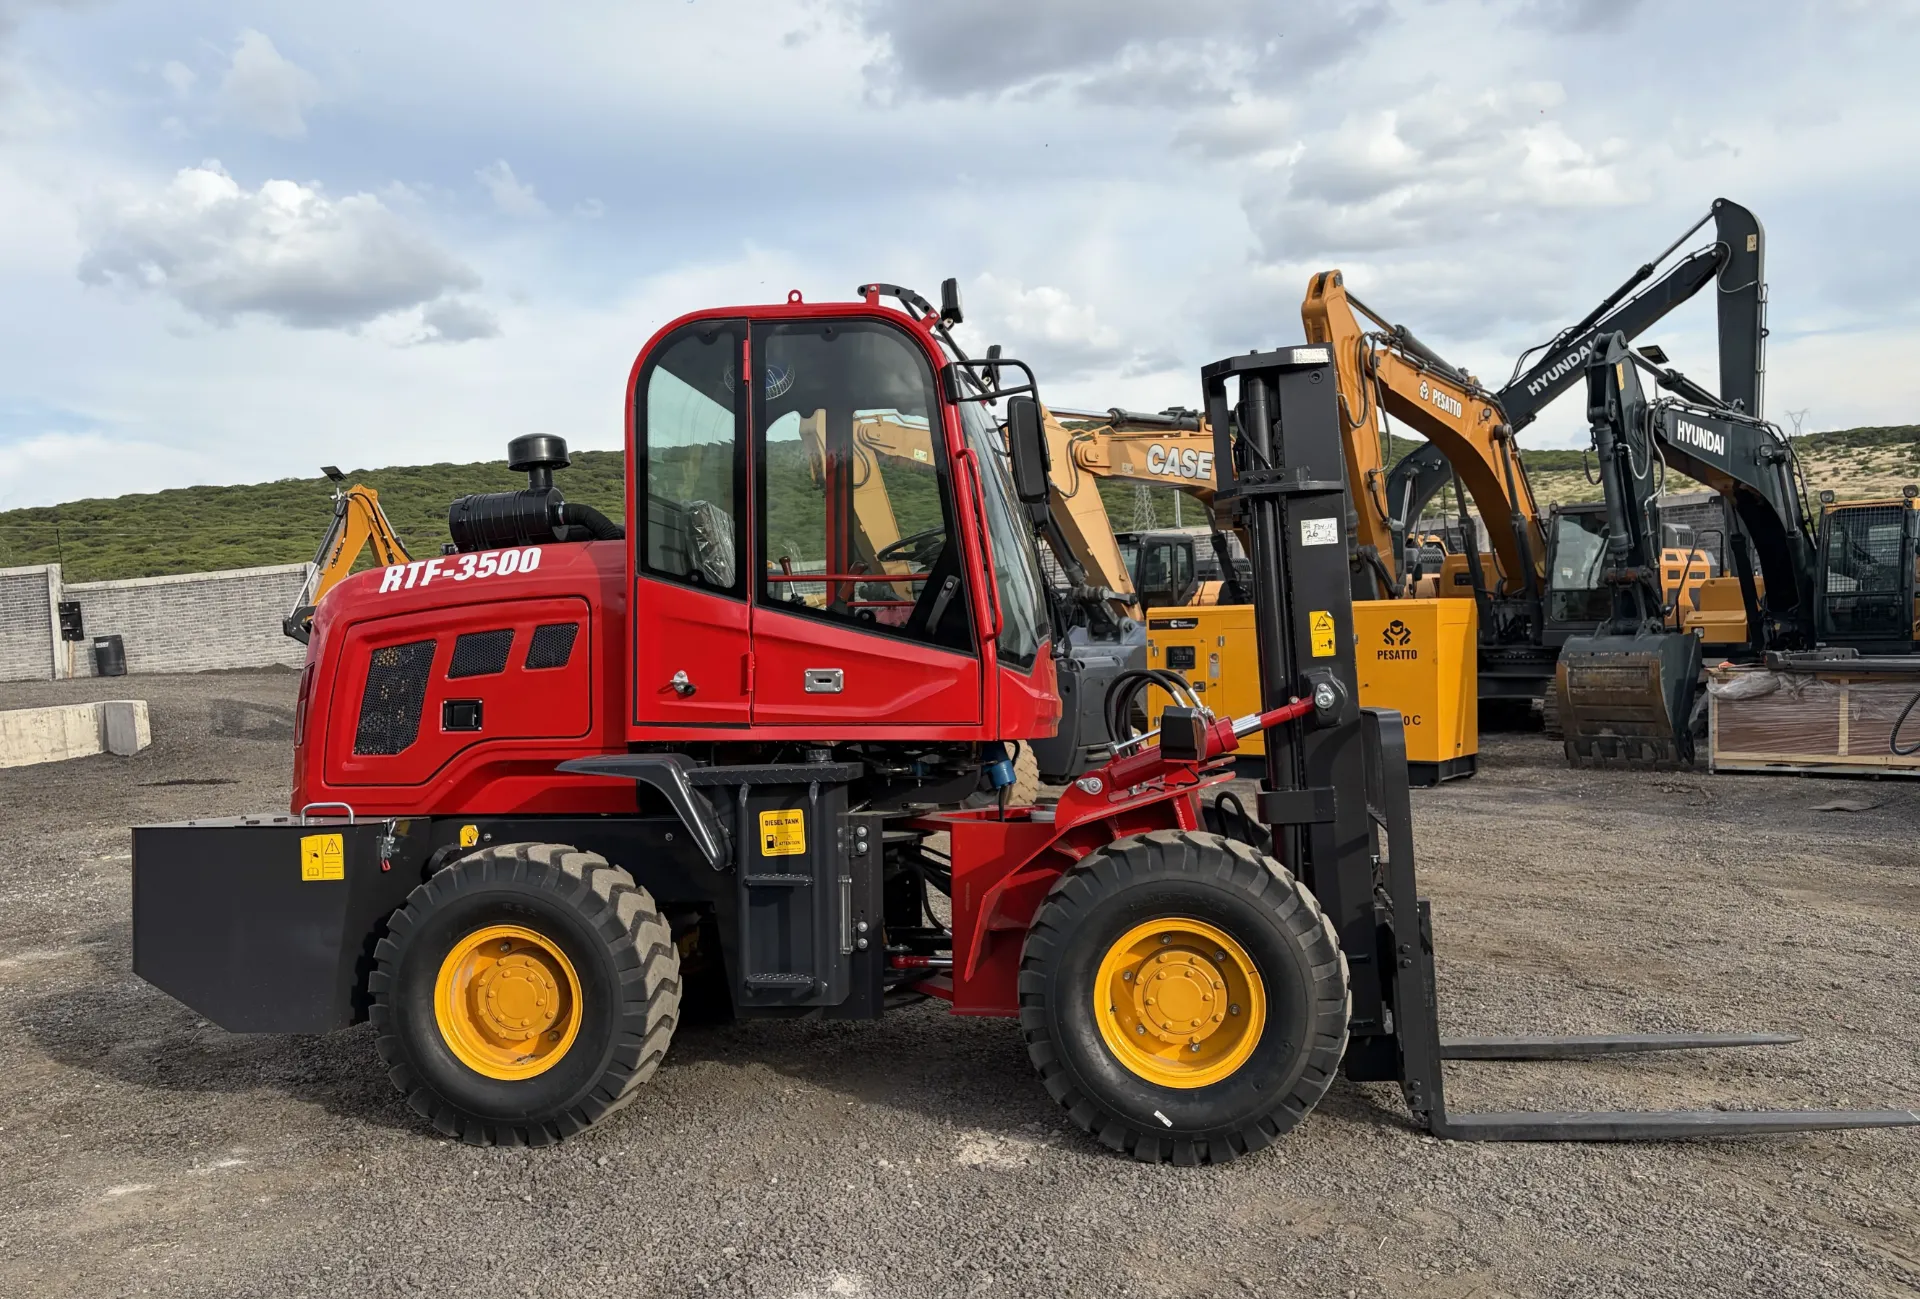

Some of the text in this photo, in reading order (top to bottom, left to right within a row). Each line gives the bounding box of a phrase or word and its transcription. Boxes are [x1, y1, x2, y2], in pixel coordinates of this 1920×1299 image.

[1432, 387, 1462, 419] PESATTO
[1677, 419, 1725, 456] HYUNDAI
[1146, 443, 1214, 480] CASE
[378, 547, 542, 594] RTF-3500
[1377, 649, 1418, 660] PESATTO
